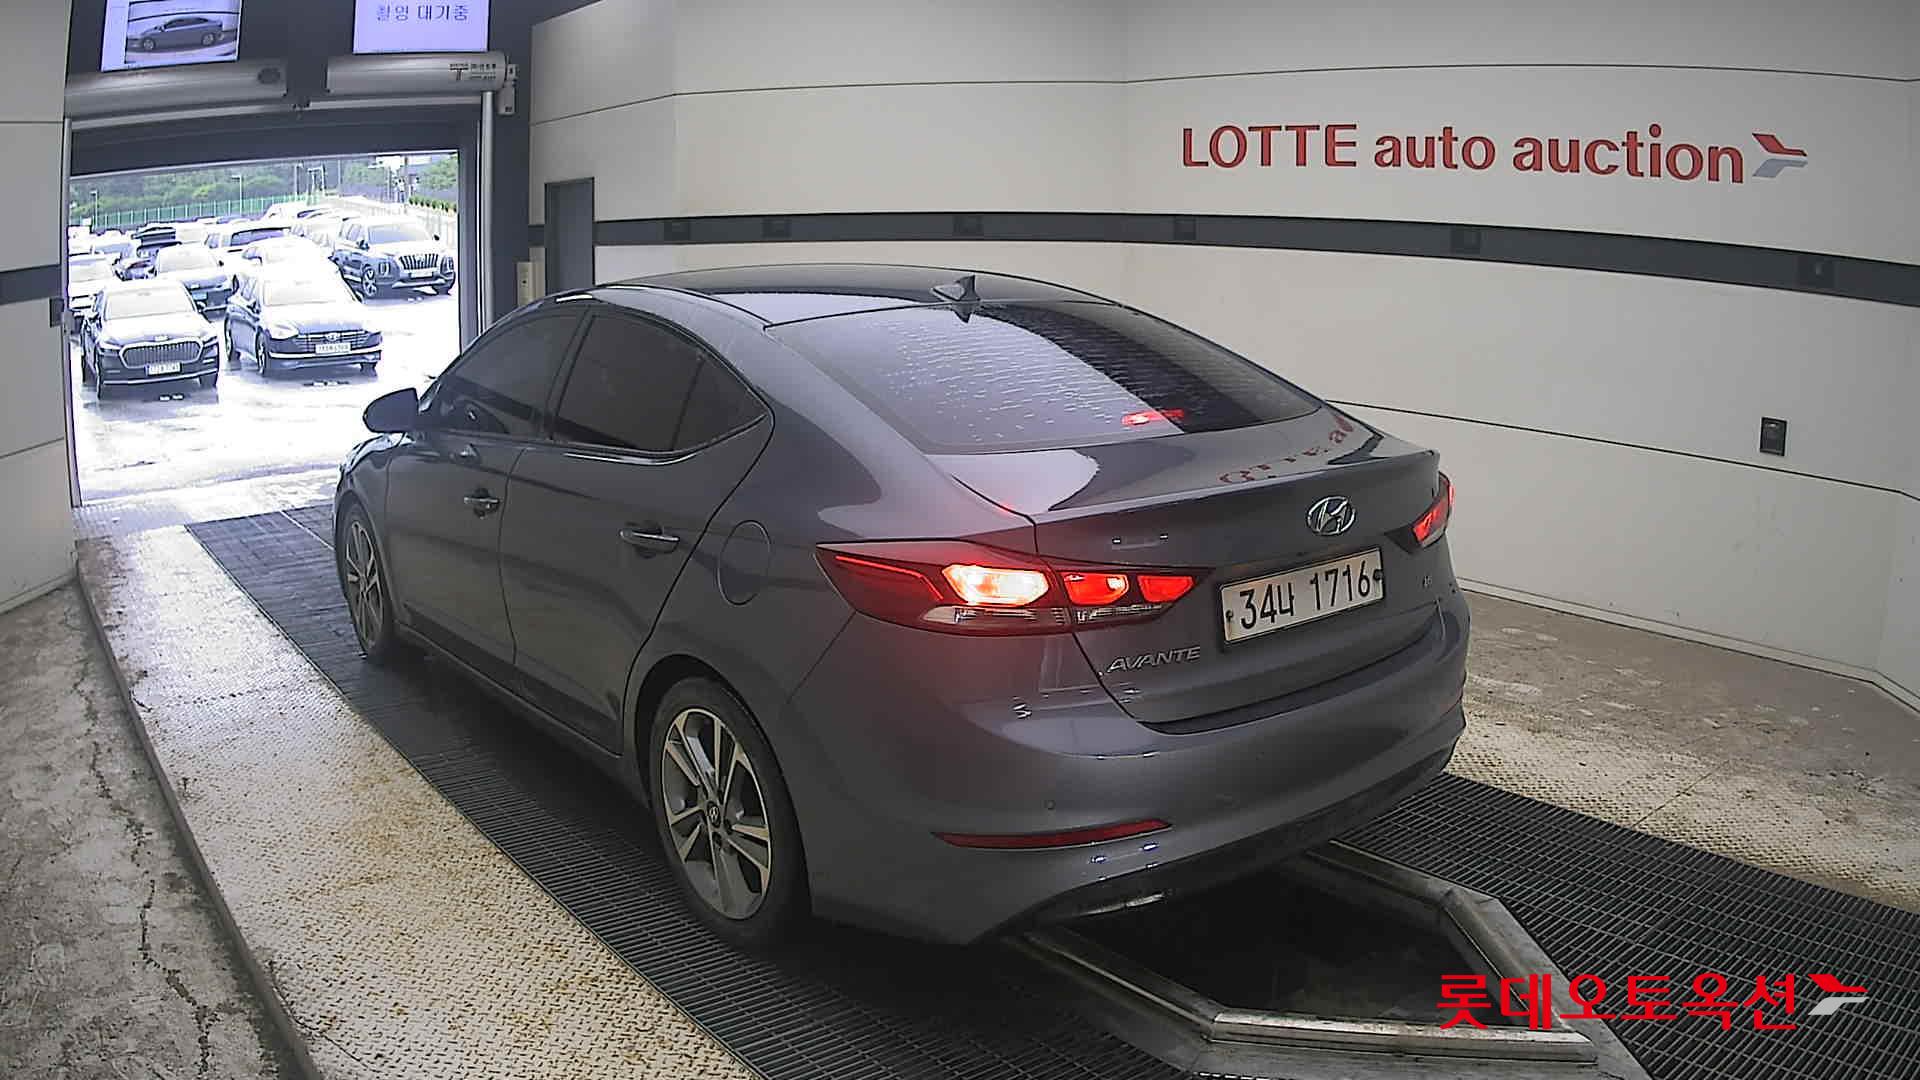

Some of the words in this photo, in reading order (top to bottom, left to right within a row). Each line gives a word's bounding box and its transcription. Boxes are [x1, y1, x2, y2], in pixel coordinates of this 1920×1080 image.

[417, 4, 469, 21] 대기중
[1182, 123, 1357, 168] LOTTE
[1374, 125, 1496, 171] auto
[1512, 122, 1744, 184] auction
[1239, 582, 1295, 630] 34나
[1310, 560, 1371, 611] 1716
[1106, 645, 1201, 673] AVANTE
